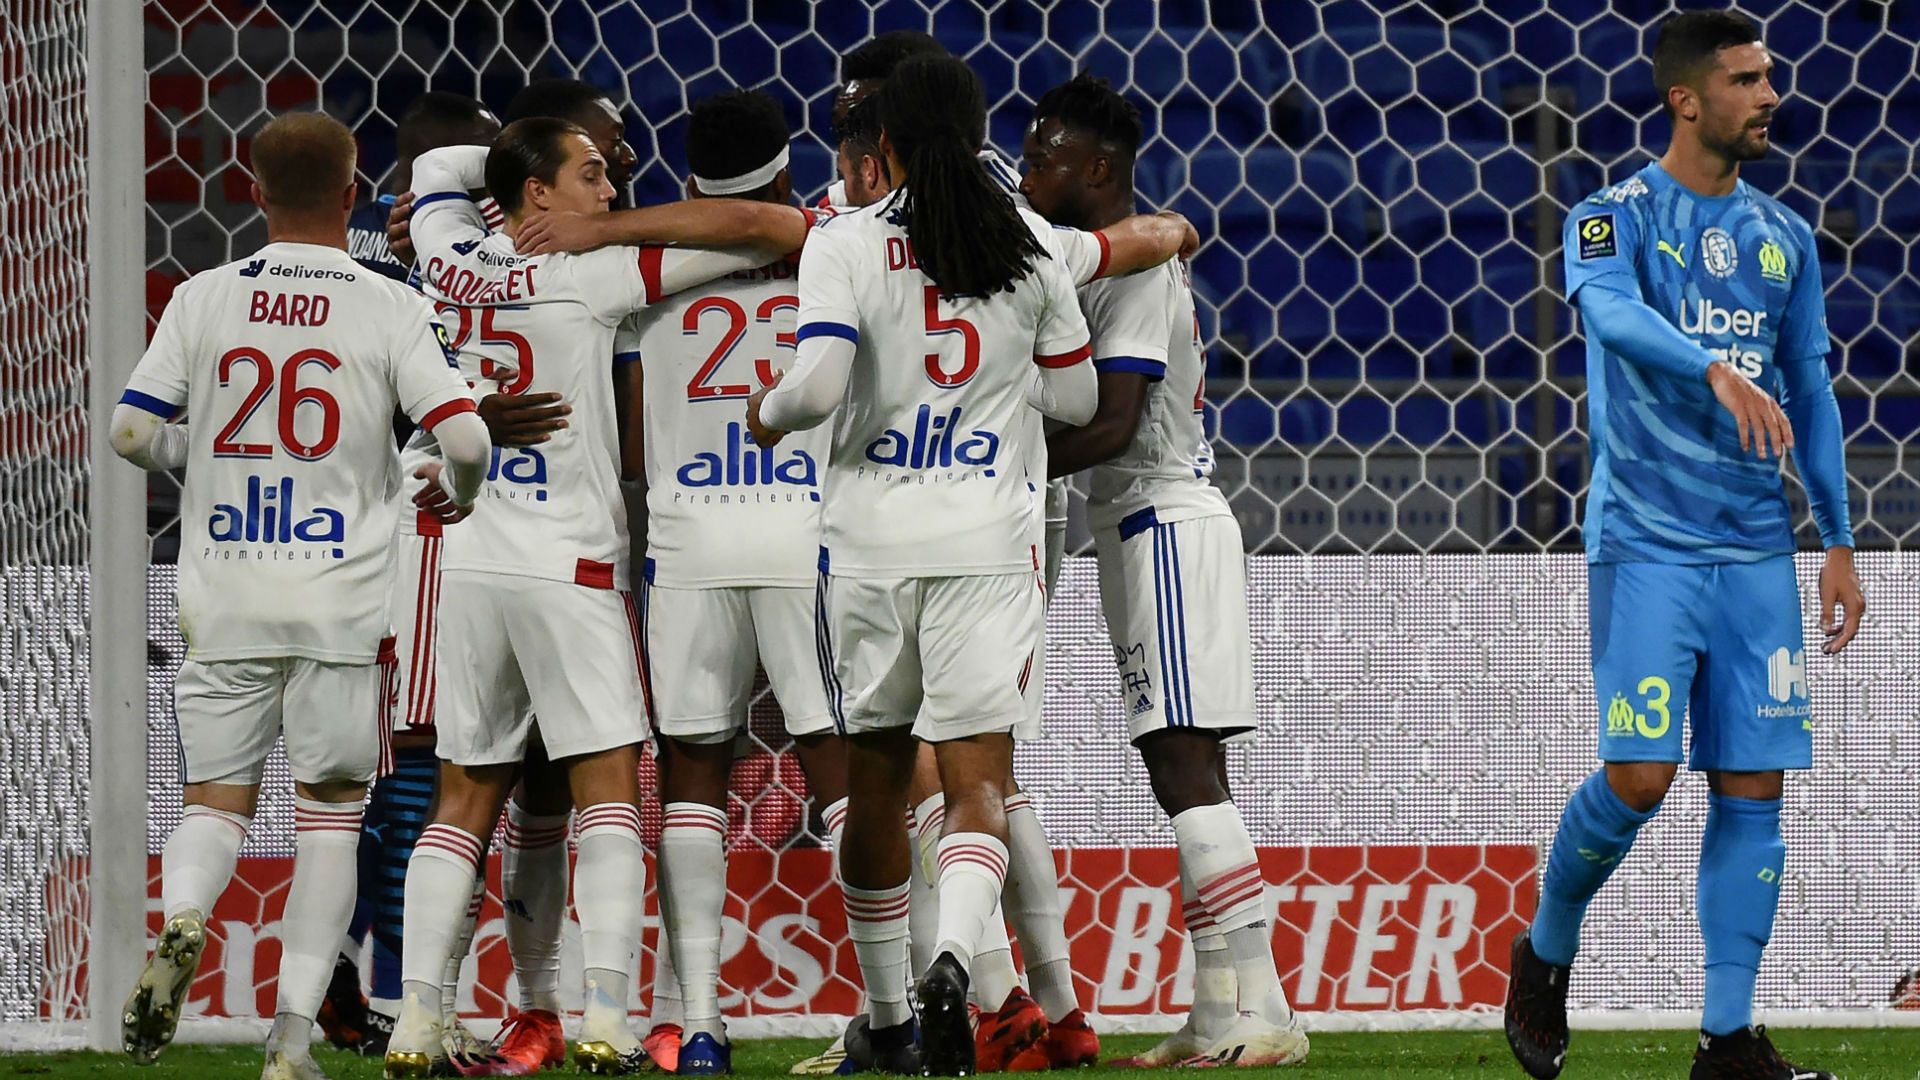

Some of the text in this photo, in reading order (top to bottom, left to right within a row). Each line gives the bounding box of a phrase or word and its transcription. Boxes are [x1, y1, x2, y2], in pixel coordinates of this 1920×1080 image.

[269, 263, 356, 282] deliveroo
[249, 290, 330, 327] BARD
[1679, 298, 1767, 337] Uber
[924, 285, 982, 389] 5
[1692, 340, 1762, 378] ts
[213, 346, 342, 462] 26
[676, 421, 818, 487] alila
[865, 403, 1000, 469] alila
[208, 474, 344, 544] alila
[674, 491, 805, 504] Promoteur
[203, 547, 326, 561] Promoteur
[1635, 675, 1671, 739] 3
